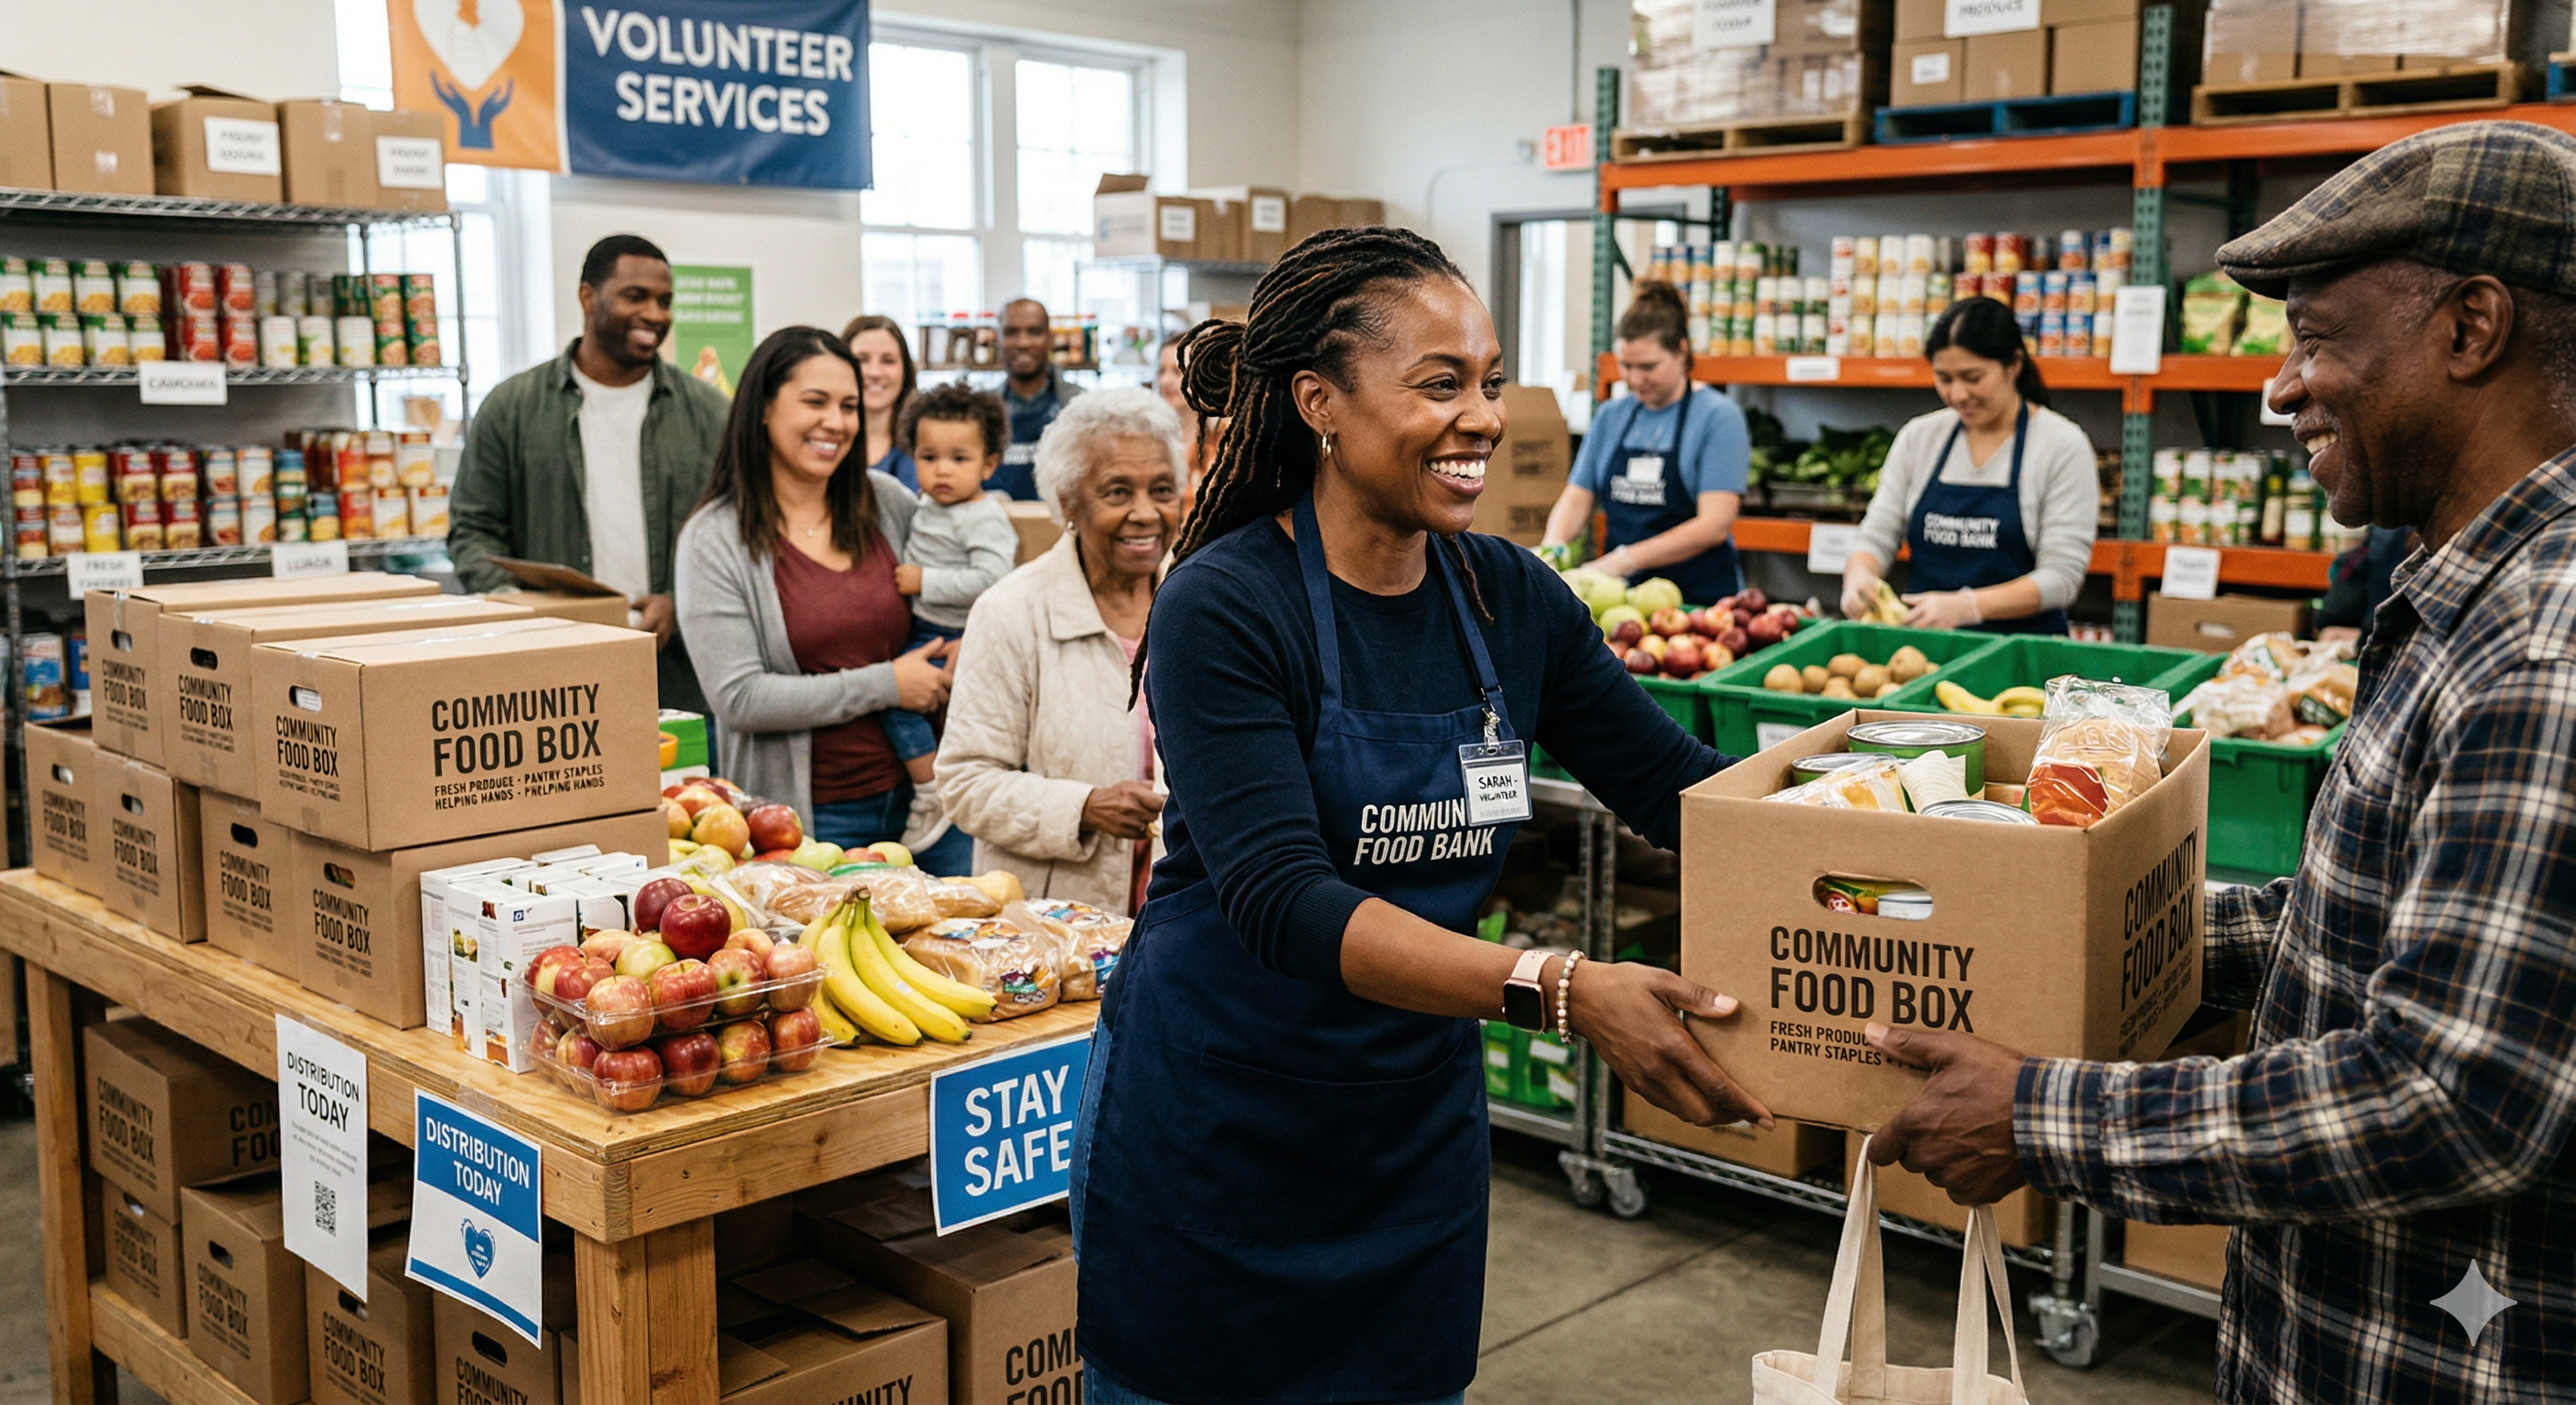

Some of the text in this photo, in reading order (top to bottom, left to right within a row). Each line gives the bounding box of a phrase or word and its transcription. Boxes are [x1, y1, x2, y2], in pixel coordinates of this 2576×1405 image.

[581, 5, 853, 82] VOLUNTEER
[615, 70, 831, 136] SERVICES
[1545, 126, 1589, 167] EXIT
[1924, 512, 2002, 533] COMMUNITY
[178, 674, 232, 704] COMMUNITY
[431, 683, 600, 732] COMMUNITY
[179, 696, 209, 725] FOOD
[210, 703, 233, 732] BOX
[275, 715, 338, 748] COMMUNITY
[277, 738, 339, 778] FOOD BOX
[434, 719, 602, 777] FOOD BOX
[435, 782, 467, 797] FRESH
[564, 764, 604, 779] STAPLES
[435, 794, 478, 810] HELPING
[1353, 827, 1497, 865] FOOD BANK
[221, 871, 274, 913] FOOD BOX
[313, 888, 370, 927] COMMUNITY
[2124, 826, 2199, 941] COMMUNITY
[315, 911, 344, 945] FOOD
[348, 923, 372, 957] BOX
[1771, 926, 1975, 982] COMMUNITY
[2121, 917, 2165, 1012] FOOD
[2168, 883, 2196, 964] BOX
[1771, 966, 1974, 1034] FOOD BOX
[1770, 1021, 1812, 1039] FRESH
[1770, 1037, 1821, 1057] PANTRY
[1824, 1045, 1883, 1067] STAPLES
[287, 1051, 360, 1103] DISTRIBUTION
[965, 1065, 1069, 1137] STAY
[297, 1081, 349, 1132] TODAY
[425, 1117, 531, 1190] DISTRIBUTION
[964, 1121, 1073, 1197] SAFE
[454, 1160, 502, 1207] TODAY
[325, 1334, 356, 1378] FOOD
[360, 1357, 387, 1397] BOX
[1006, 1327, 1080, 1386] COM
